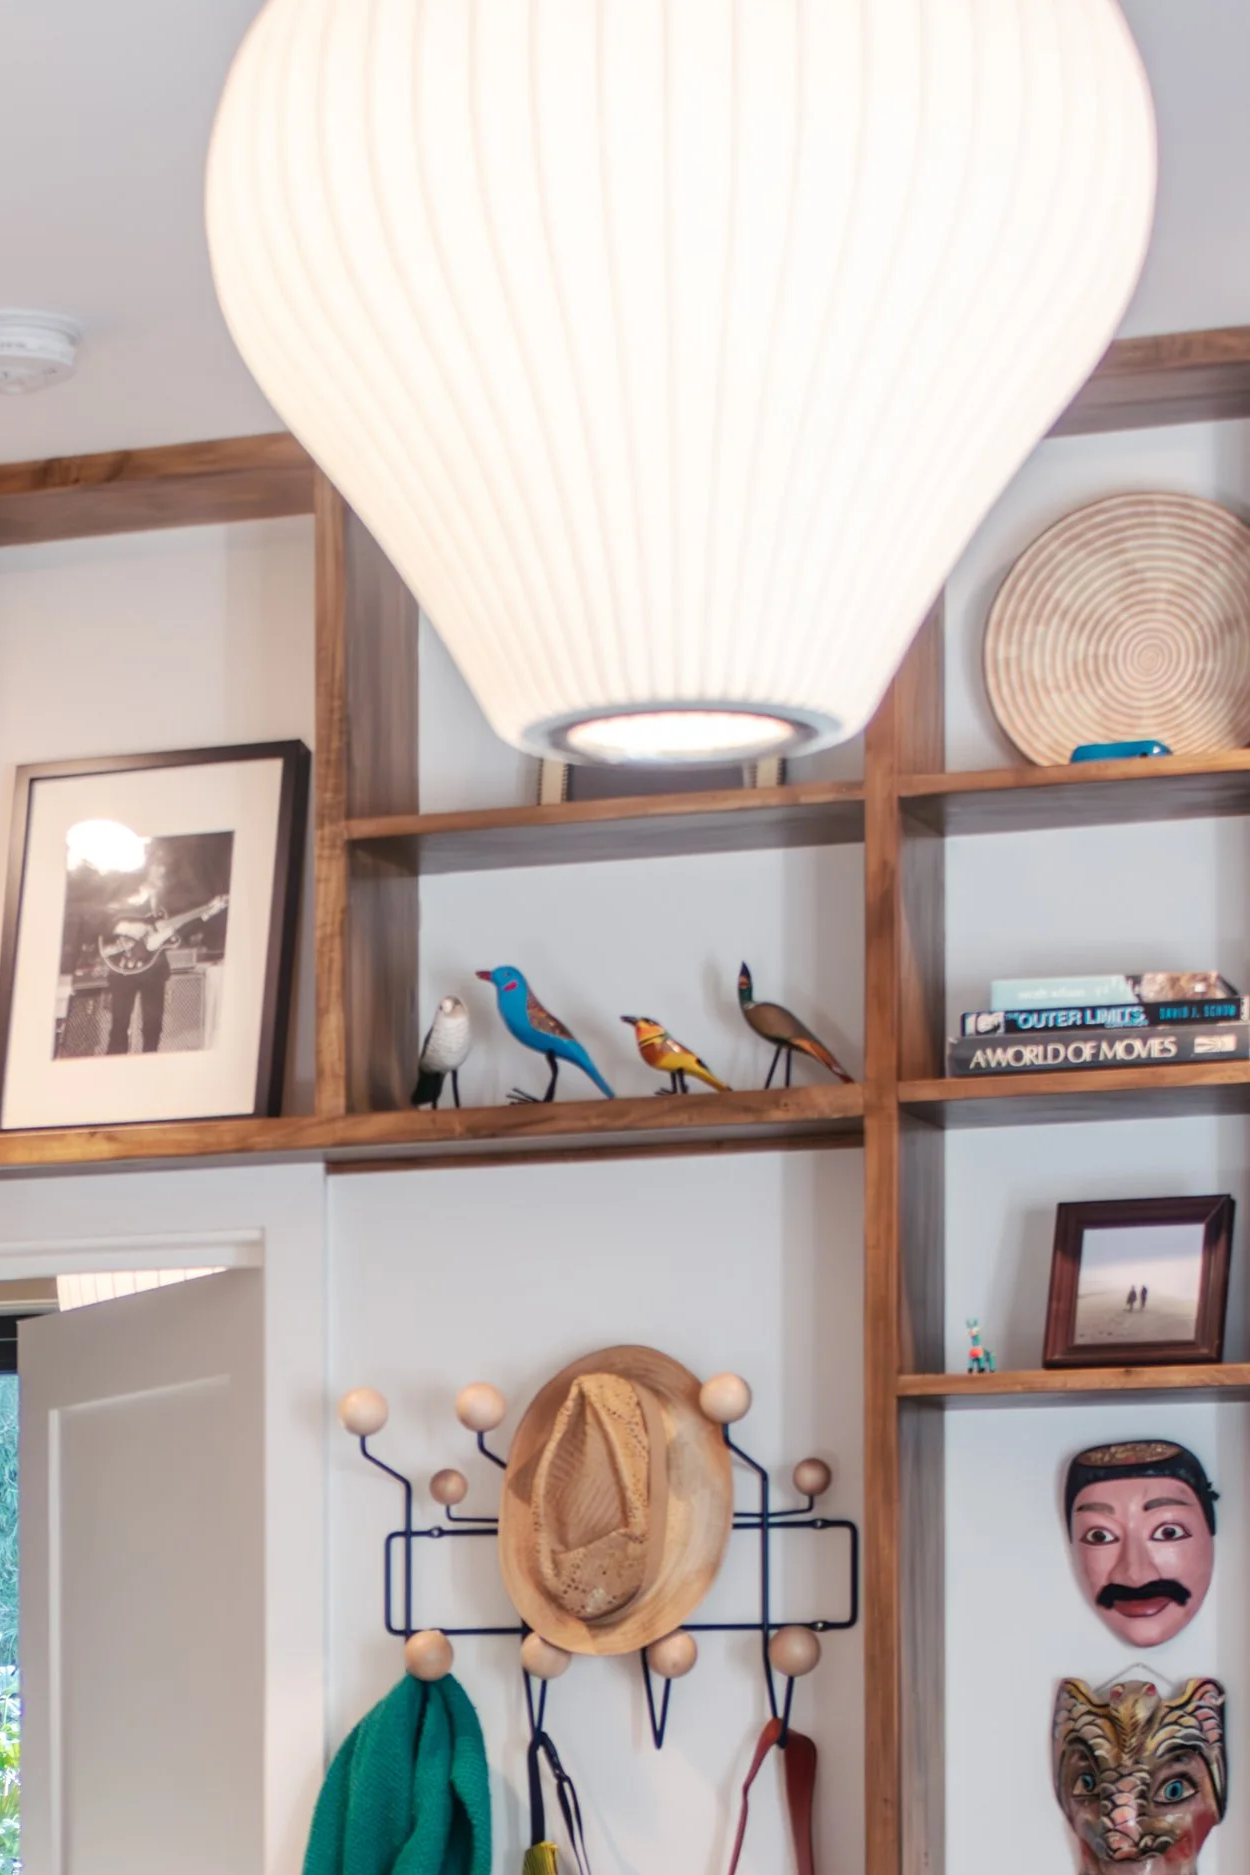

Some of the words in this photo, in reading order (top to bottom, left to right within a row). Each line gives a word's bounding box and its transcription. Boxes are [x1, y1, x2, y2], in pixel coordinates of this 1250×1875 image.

[1017, 1009, 1083, 1030] OUTER
[1084, 1005, 1147, 1026] LIMITS
[969, 1049, 986, 1070] A
[985, 1042, 1067, 1068] WORLD
[1067, 1039, 1098, 1064] OF
[1099, 1035, 1179, 1061] MOVIES
